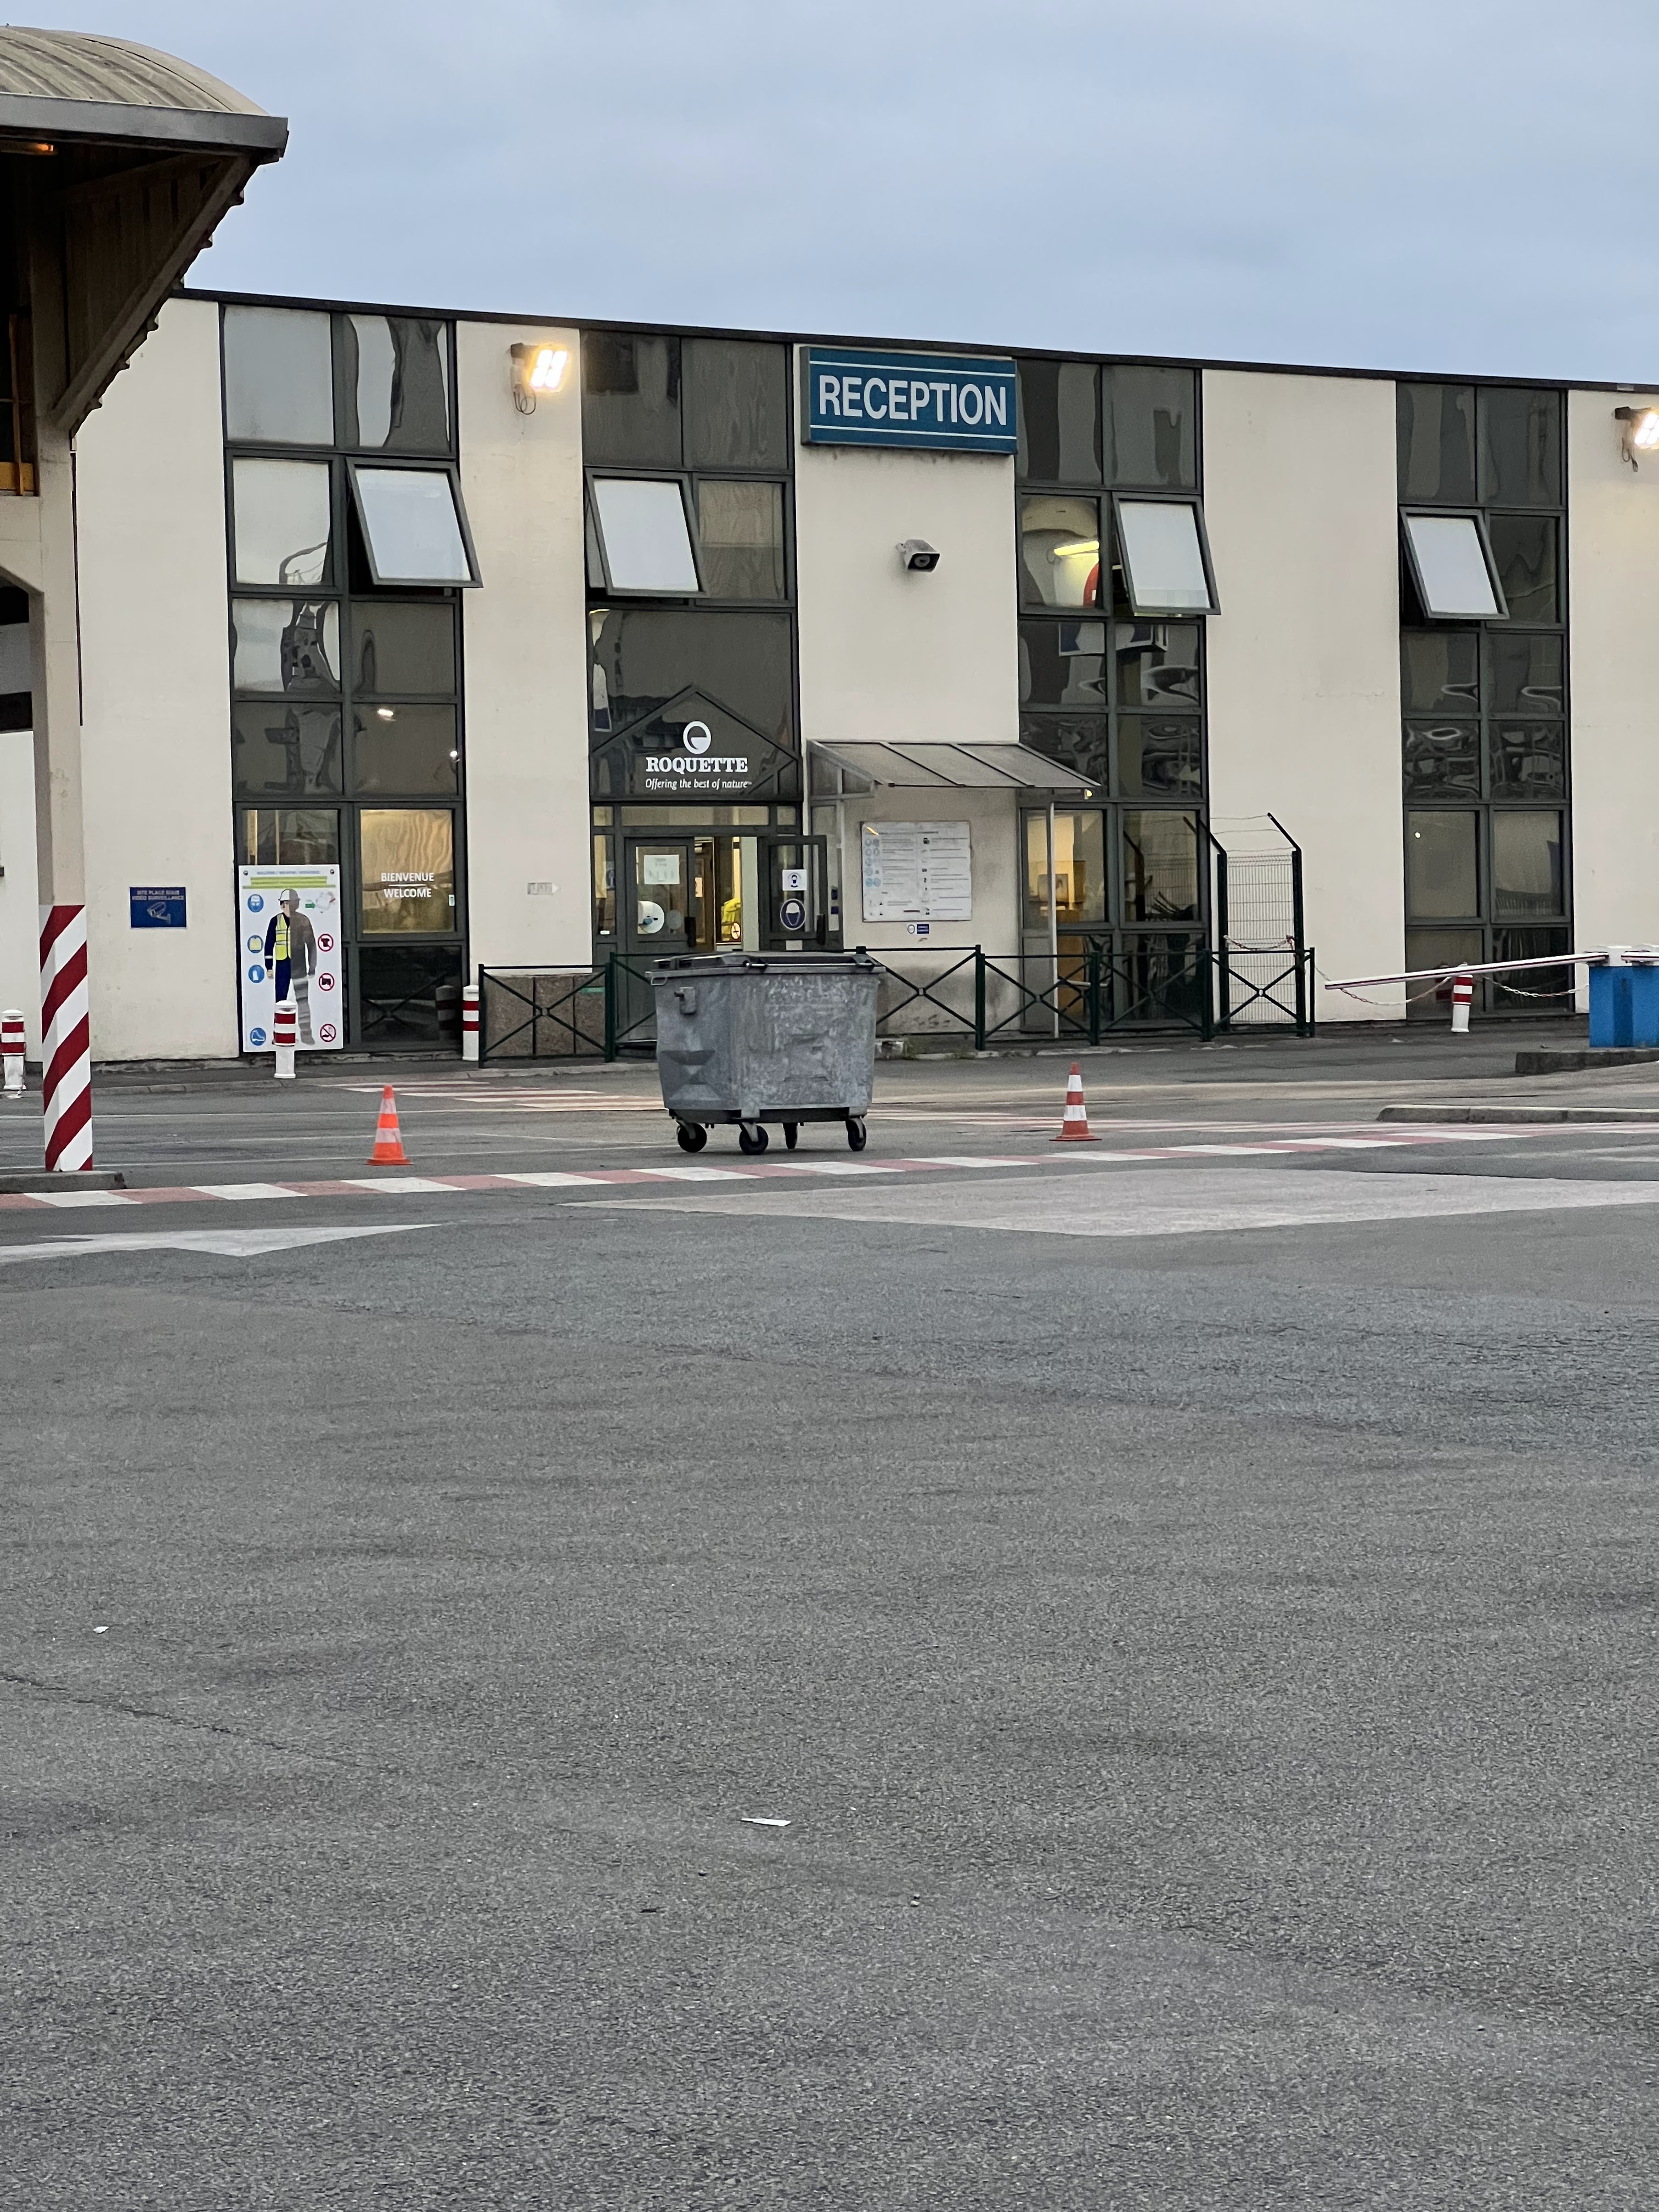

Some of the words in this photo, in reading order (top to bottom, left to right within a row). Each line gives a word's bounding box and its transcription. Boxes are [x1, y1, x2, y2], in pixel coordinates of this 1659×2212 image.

[819, 375, 1007, 426] RECEPTION
[646, 757, 748, 774] ROQUETTE
[645, 778, 677, 790] Offering
[679, 778, 691, 788] the
[693, 778, 709, 788] best
[712, 778, 720, 790] of
[381, 872, 435, 882] BIENVENUE
[383, 888, 432, 898] WELCOME
